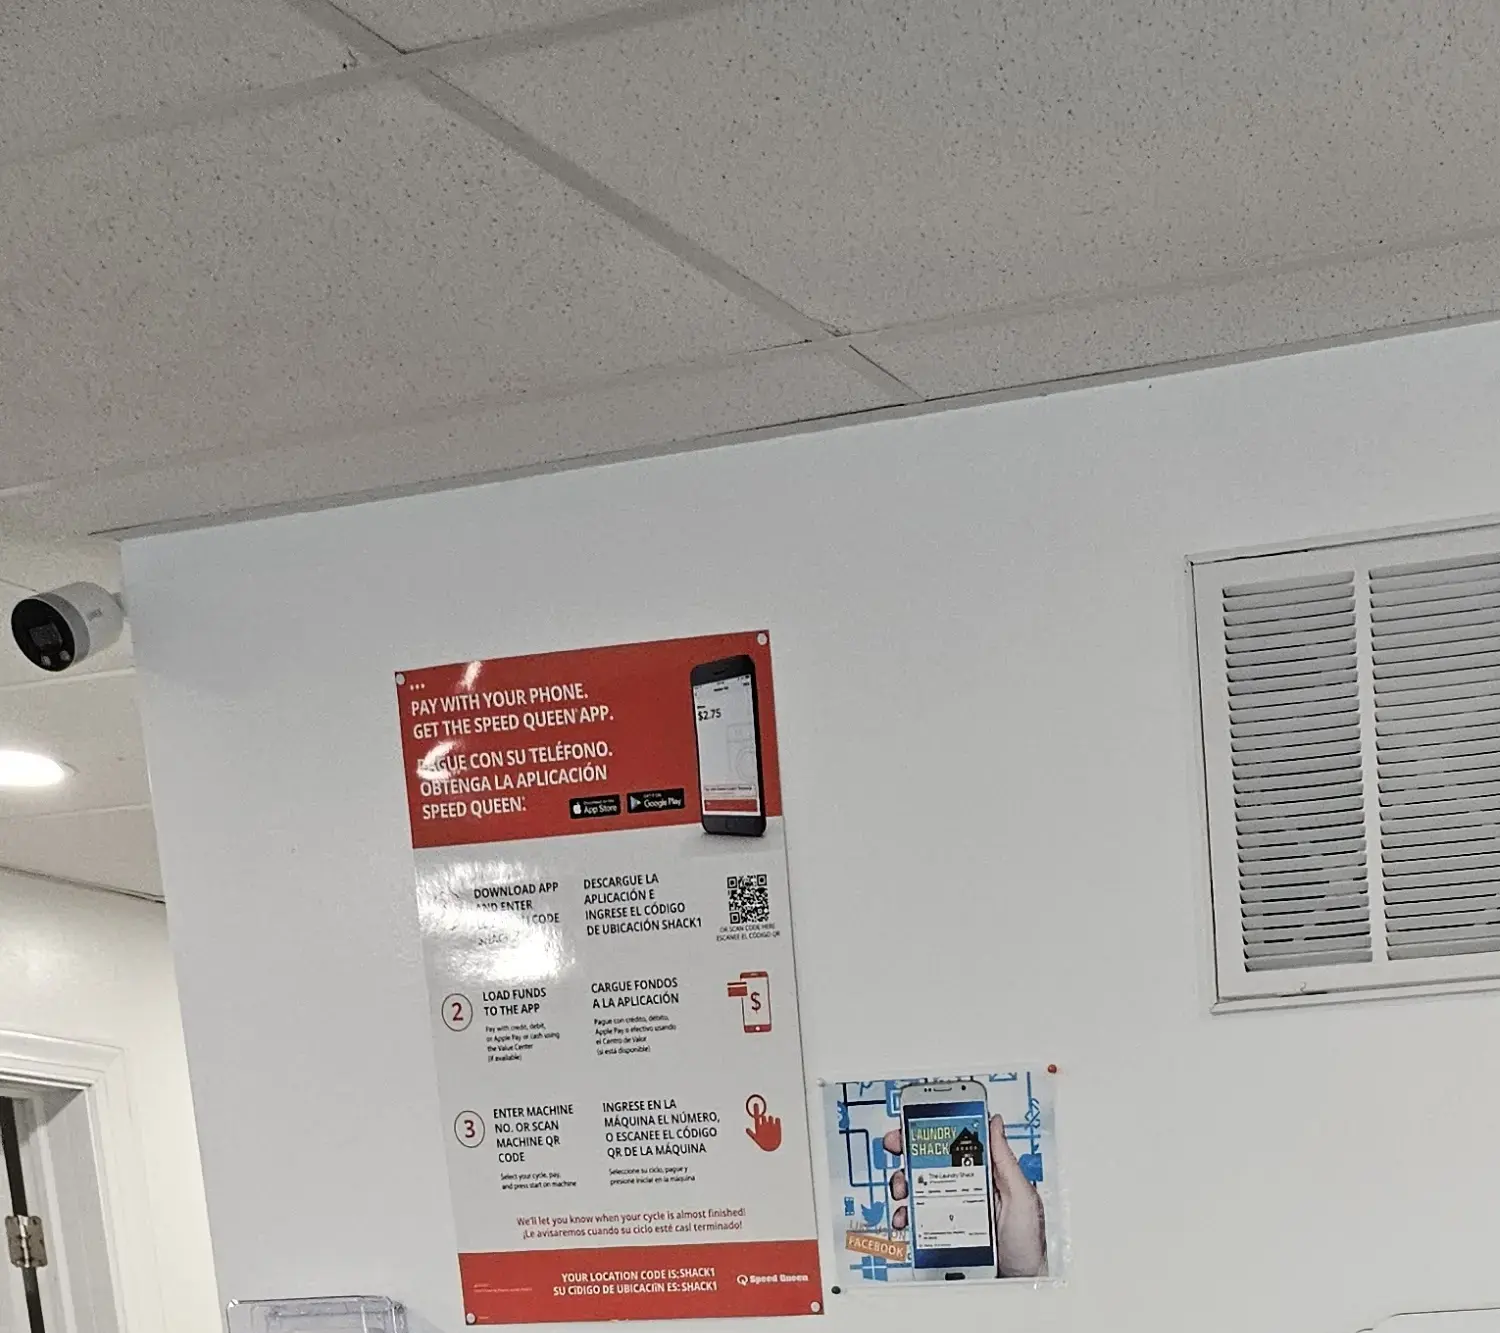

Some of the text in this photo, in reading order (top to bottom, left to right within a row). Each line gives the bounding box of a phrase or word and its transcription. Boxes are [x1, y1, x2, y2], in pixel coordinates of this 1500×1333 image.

[411, 683, 588, 716] PAY WITH YOUR PHONE.
[414, 722, 439, 739] GET
[442, 718, 471, 736] THE
[474, 714, 519, 733] SPEED
[580, 705, 614, 722] APP.
[697, 708, 721, 721] $2.75
[470, 752, 503, 770] CON
[507, 749, 525, 766] SU
[529, 741, 613, 763] TELÉFONO.
[420, 763, 607, 797] OBTENGA LA APLICACIÓN
[423, 800, 466, 820] SPEED
[584, 804, 617, 814] App Store
[644, 798, 682, 808] Google Play
[583, 873, 659, 889] DESCARGUE LA
[474, 882, 559, 899] DOWNLOAD APP
[584, 889, 655, 905] APLICACIÓN E
[501, 900, 533, 911] ENTER
[585, 902, 685, 920] INGRESE EL CÓDIGO
[532, 913, 560, 924] CODE
[587, 917, 702, 935] DE UBICACIÓN SHACK1
[591, 977, 678, 993] CARGUE FONDOS
[483, 987, 546, 1002] LOAD FUNDS
[592, 991, 679, 1009] A LA APLICACIÓN
[452, 1002, 463, 1021] 2
[484, 1003, 540, 1016] TO THE APP
[493, 1104, 574, 1119] ENTER MACHINE
[603, 1099, 677, 1112] INGRESE EN LA
[495, 1120, 559, 1133] NO. OR SCAN
[604, 1111, 720, 1128] MÁQUINA EL NÚMERO,
[464, 1120, 475, 1138] 3
[606, 1126, 718, 1142] O ESCANEE EL CÓDIGO
[911, 1126, 956, 1142] LAUNDRY
[497, 1135, 560, 1148] MACHINE QR
[911, 1142, 950, 1156] SHACK
[499, 1152, 525, 1162] CODE
[607, 1142, 707, 1159] QR DE LA MÁQUINA
[516, 1207, 746, 1227] We'll let you know when your cycle is almost finished!
[537, 1228, 585, 1238] avisaremos
[587, 1226, 619, 1236] cuando
[621, 1226, 631, 1235] su
[633, 1224, 651, 1234] ciclo
[694, 1221, 742, 1231] terminado!
[849, 1236, 903, 1257] FACEBOOK
[561, 1267, 715, 1283] YOUR LOCATION CODE IS: SHACK1
[750, 1274, 808, 1284] Speed Queen
[553, 1286, 566, 1296] SU
[603, 1285, 615, 1294] DE
[667, 1282, 681, 1292] ES:
[682, 1281, 717, 1291] SHACK1
